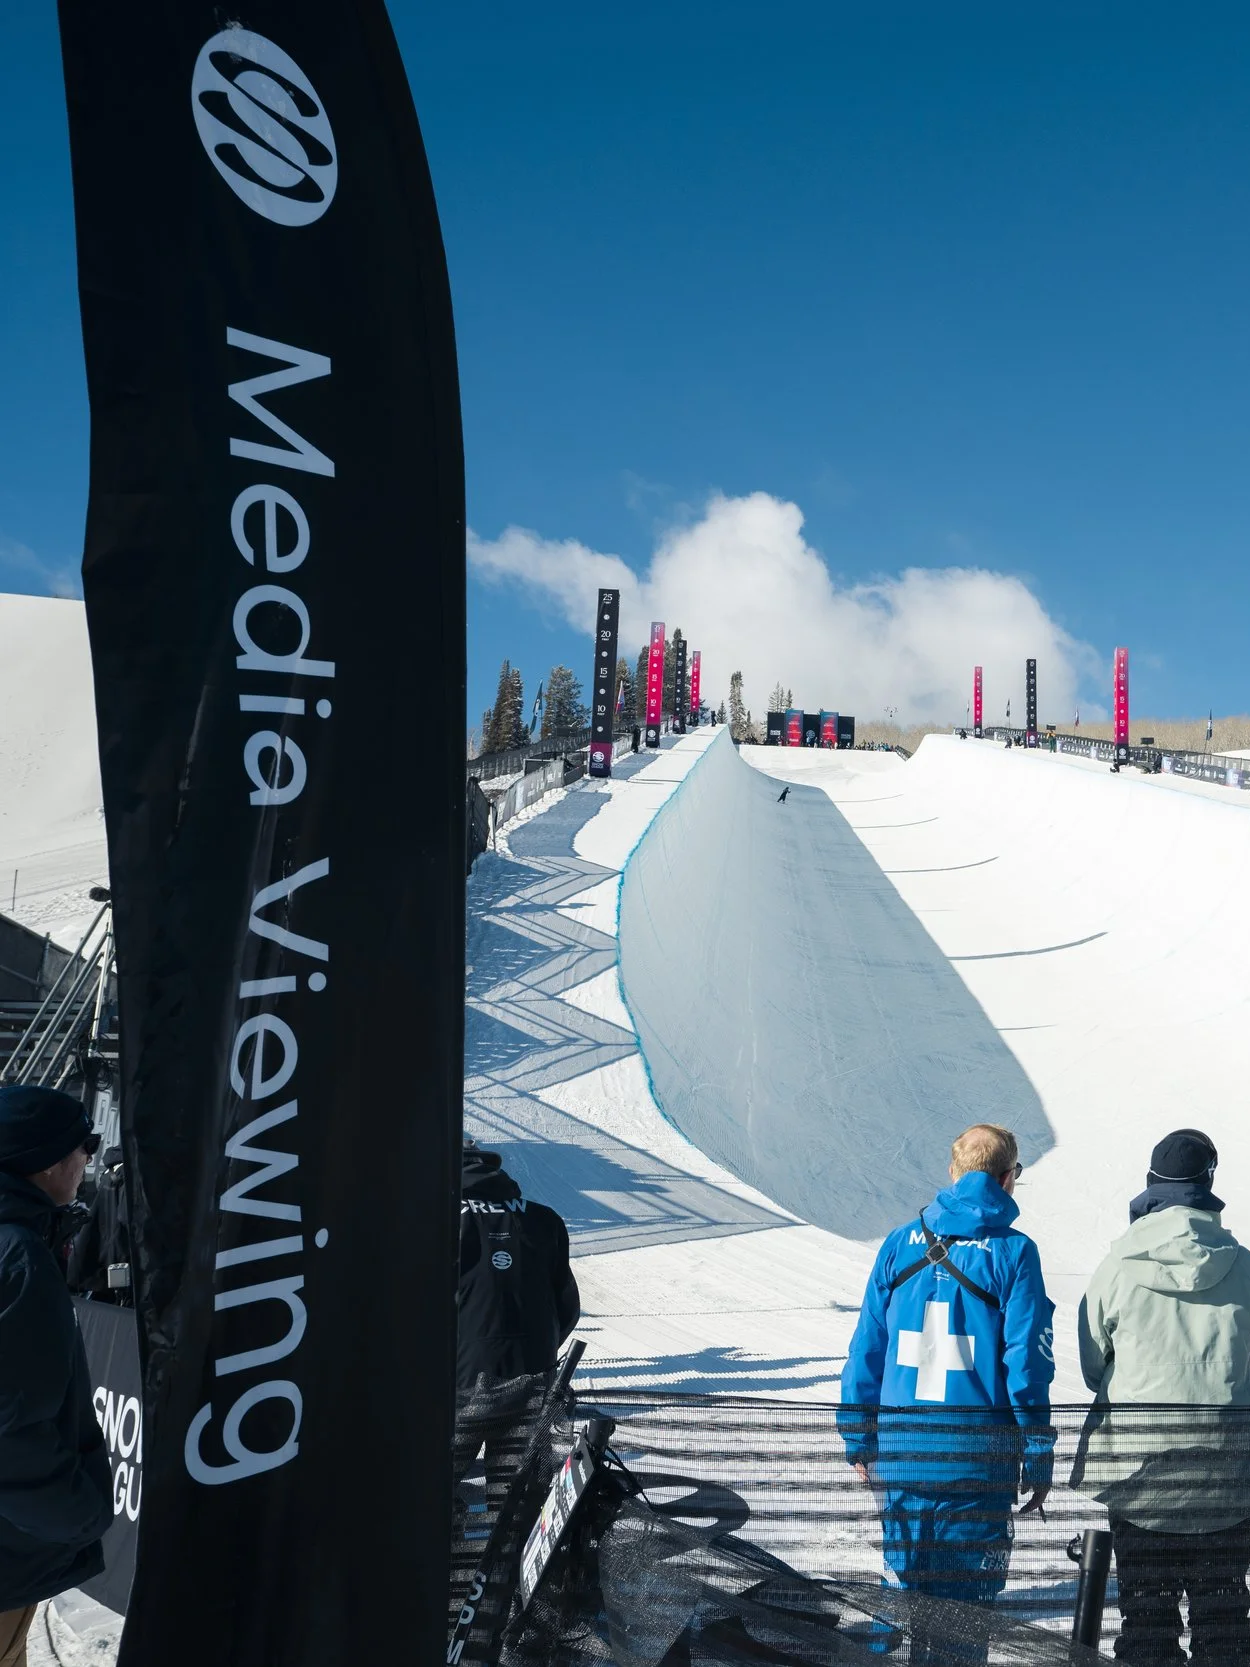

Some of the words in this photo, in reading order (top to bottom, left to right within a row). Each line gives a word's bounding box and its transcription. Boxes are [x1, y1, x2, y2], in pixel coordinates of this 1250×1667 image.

[226, 326, 335, 807] Media
[600, 630, 611, 638] 20
[600, 667, 608, 675] 15
[184, 857, 330, 1485] viewing
